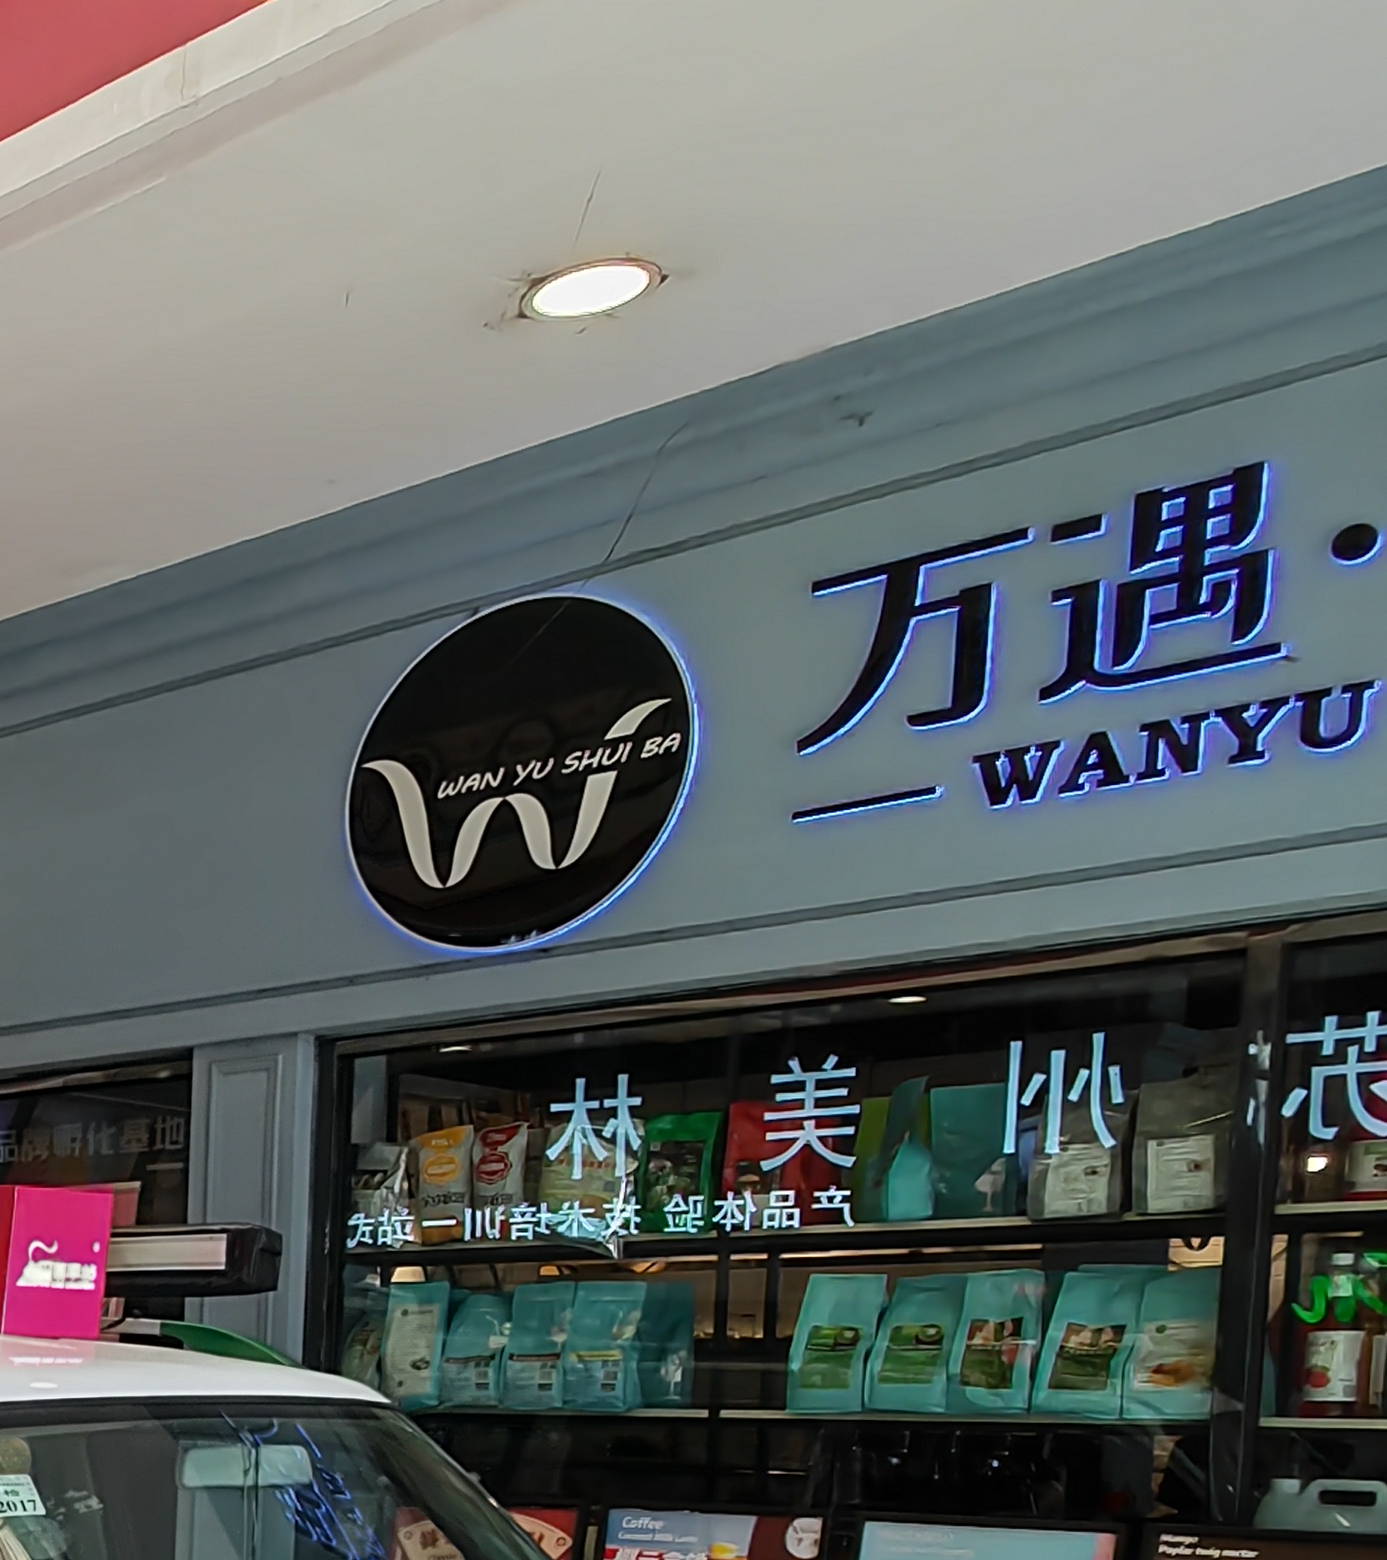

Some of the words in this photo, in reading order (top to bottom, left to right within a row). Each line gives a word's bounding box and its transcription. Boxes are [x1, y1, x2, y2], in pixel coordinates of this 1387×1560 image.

[437, 767, 505, 799] WAN
[513, 757, 554, 787] YU
[561, 741, 633, 775] SHUI
[640, 731, 683, 760] BA
[971, 680, 1384, 811] WANYU
[622, 1516, 664, 1530] Coffee
